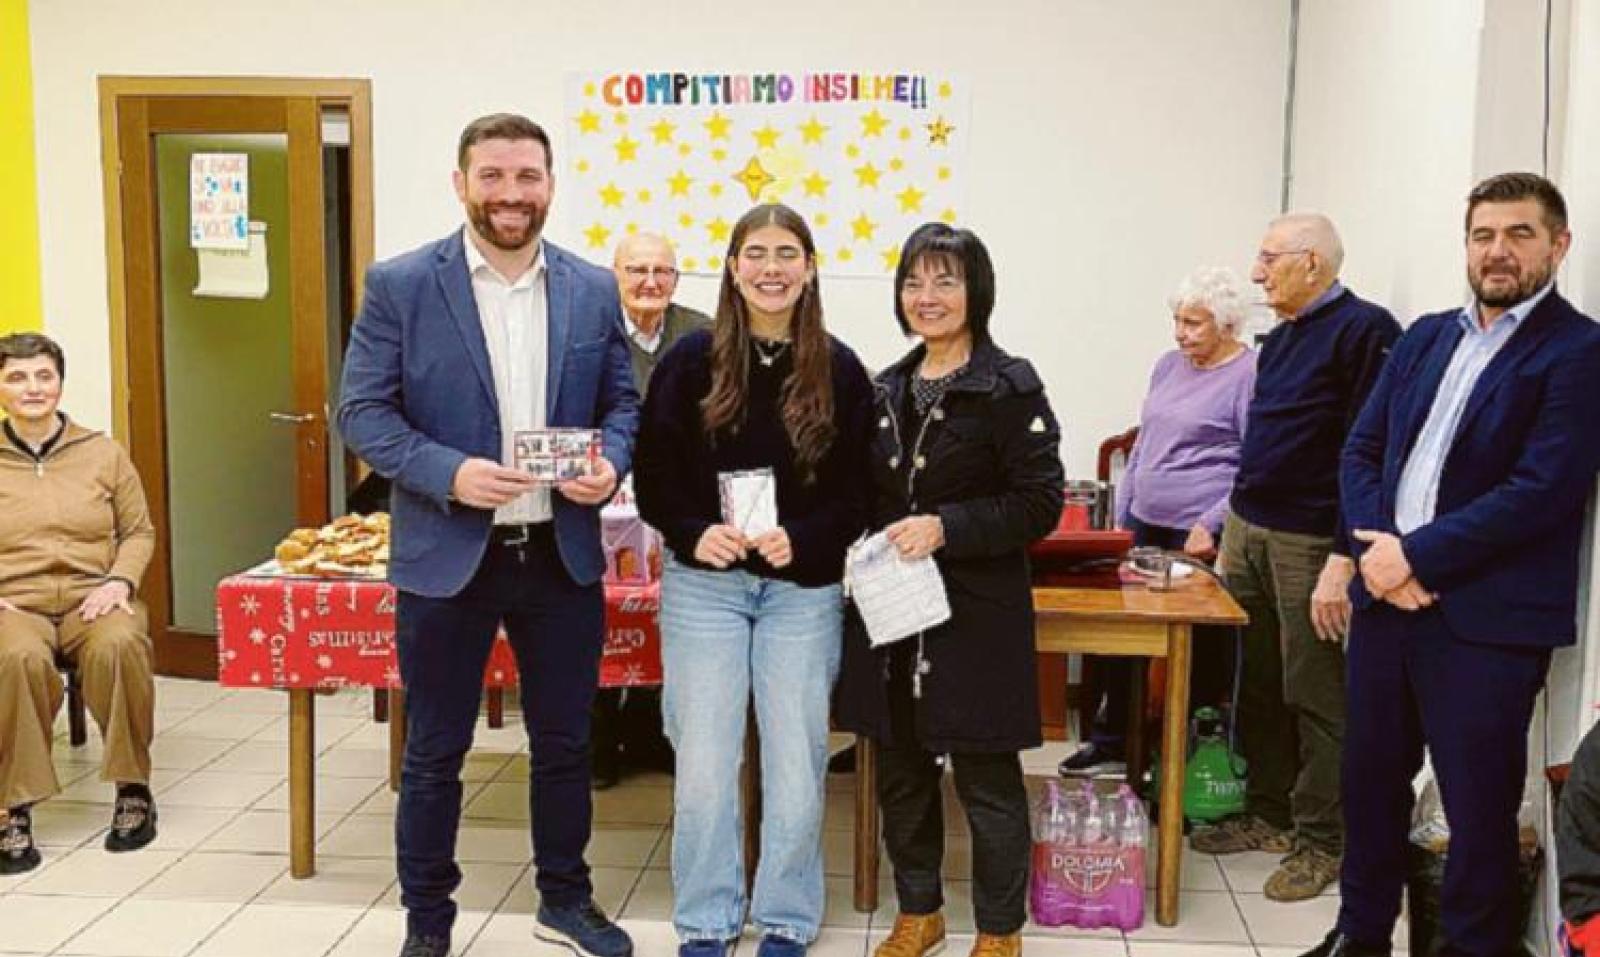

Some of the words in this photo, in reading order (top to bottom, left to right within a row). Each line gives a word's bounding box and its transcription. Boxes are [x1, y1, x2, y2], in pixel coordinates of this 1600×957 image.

[603, 73, 794, 105] COMPITIAMO
[804, 73, 927, 108] INSIEME!!
[1052, 854, 1125, 871] DOLOMIA
